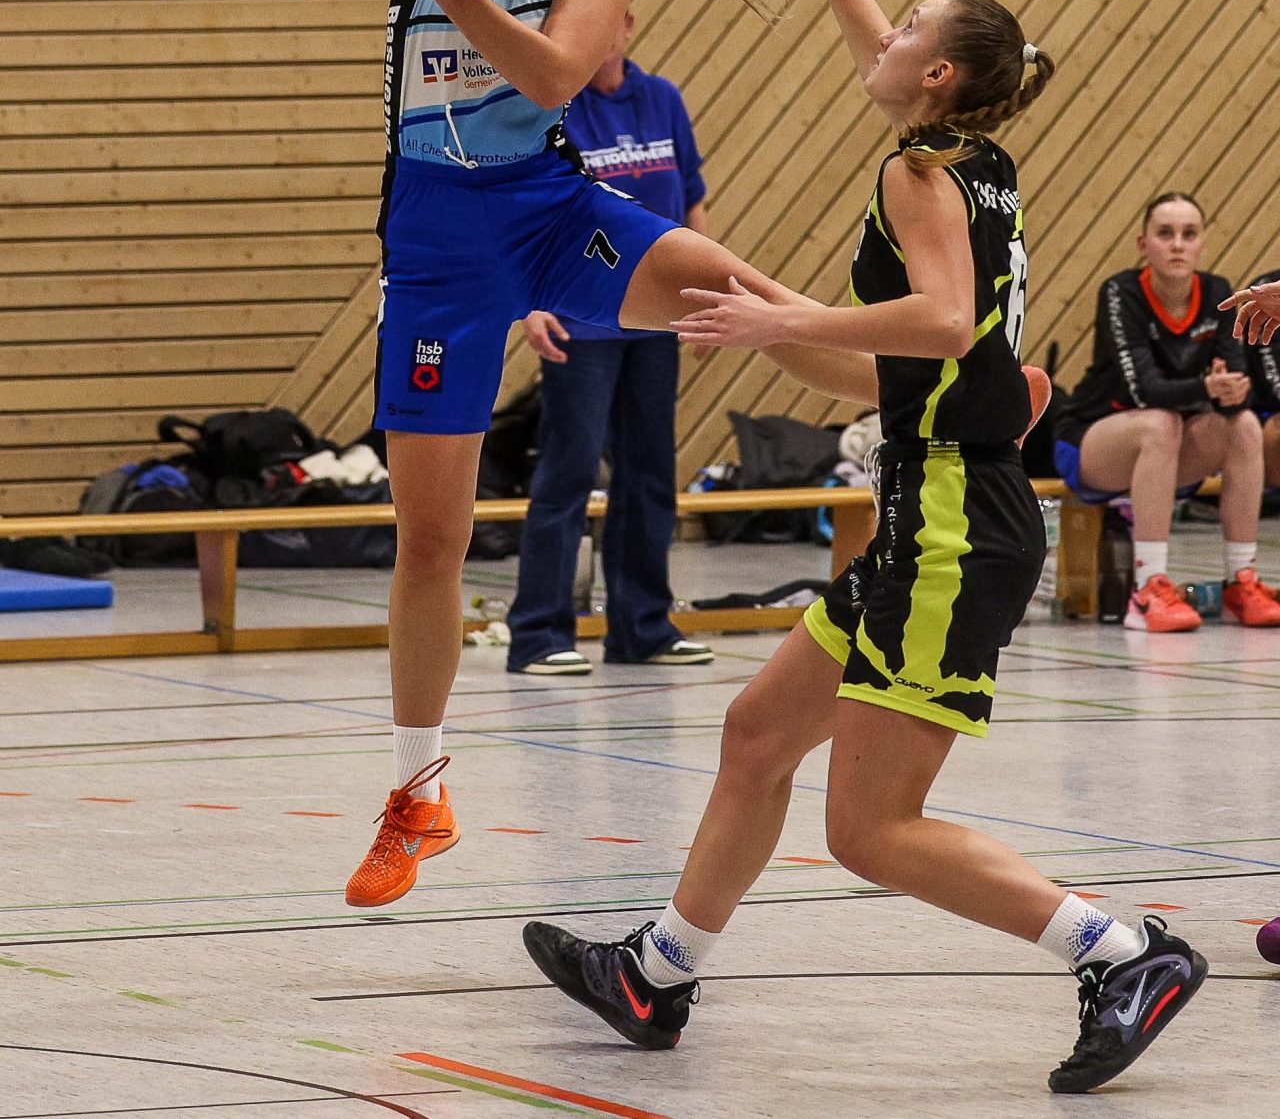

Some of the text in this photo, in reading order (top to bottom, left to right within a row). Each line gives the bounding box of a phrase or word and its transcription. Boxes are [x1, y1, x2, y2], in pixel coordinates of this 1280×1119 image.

[584, 229, 620, 269] 7
[417, 339, 443, 354] hsb
[416, 353, 441, 365] 1846
